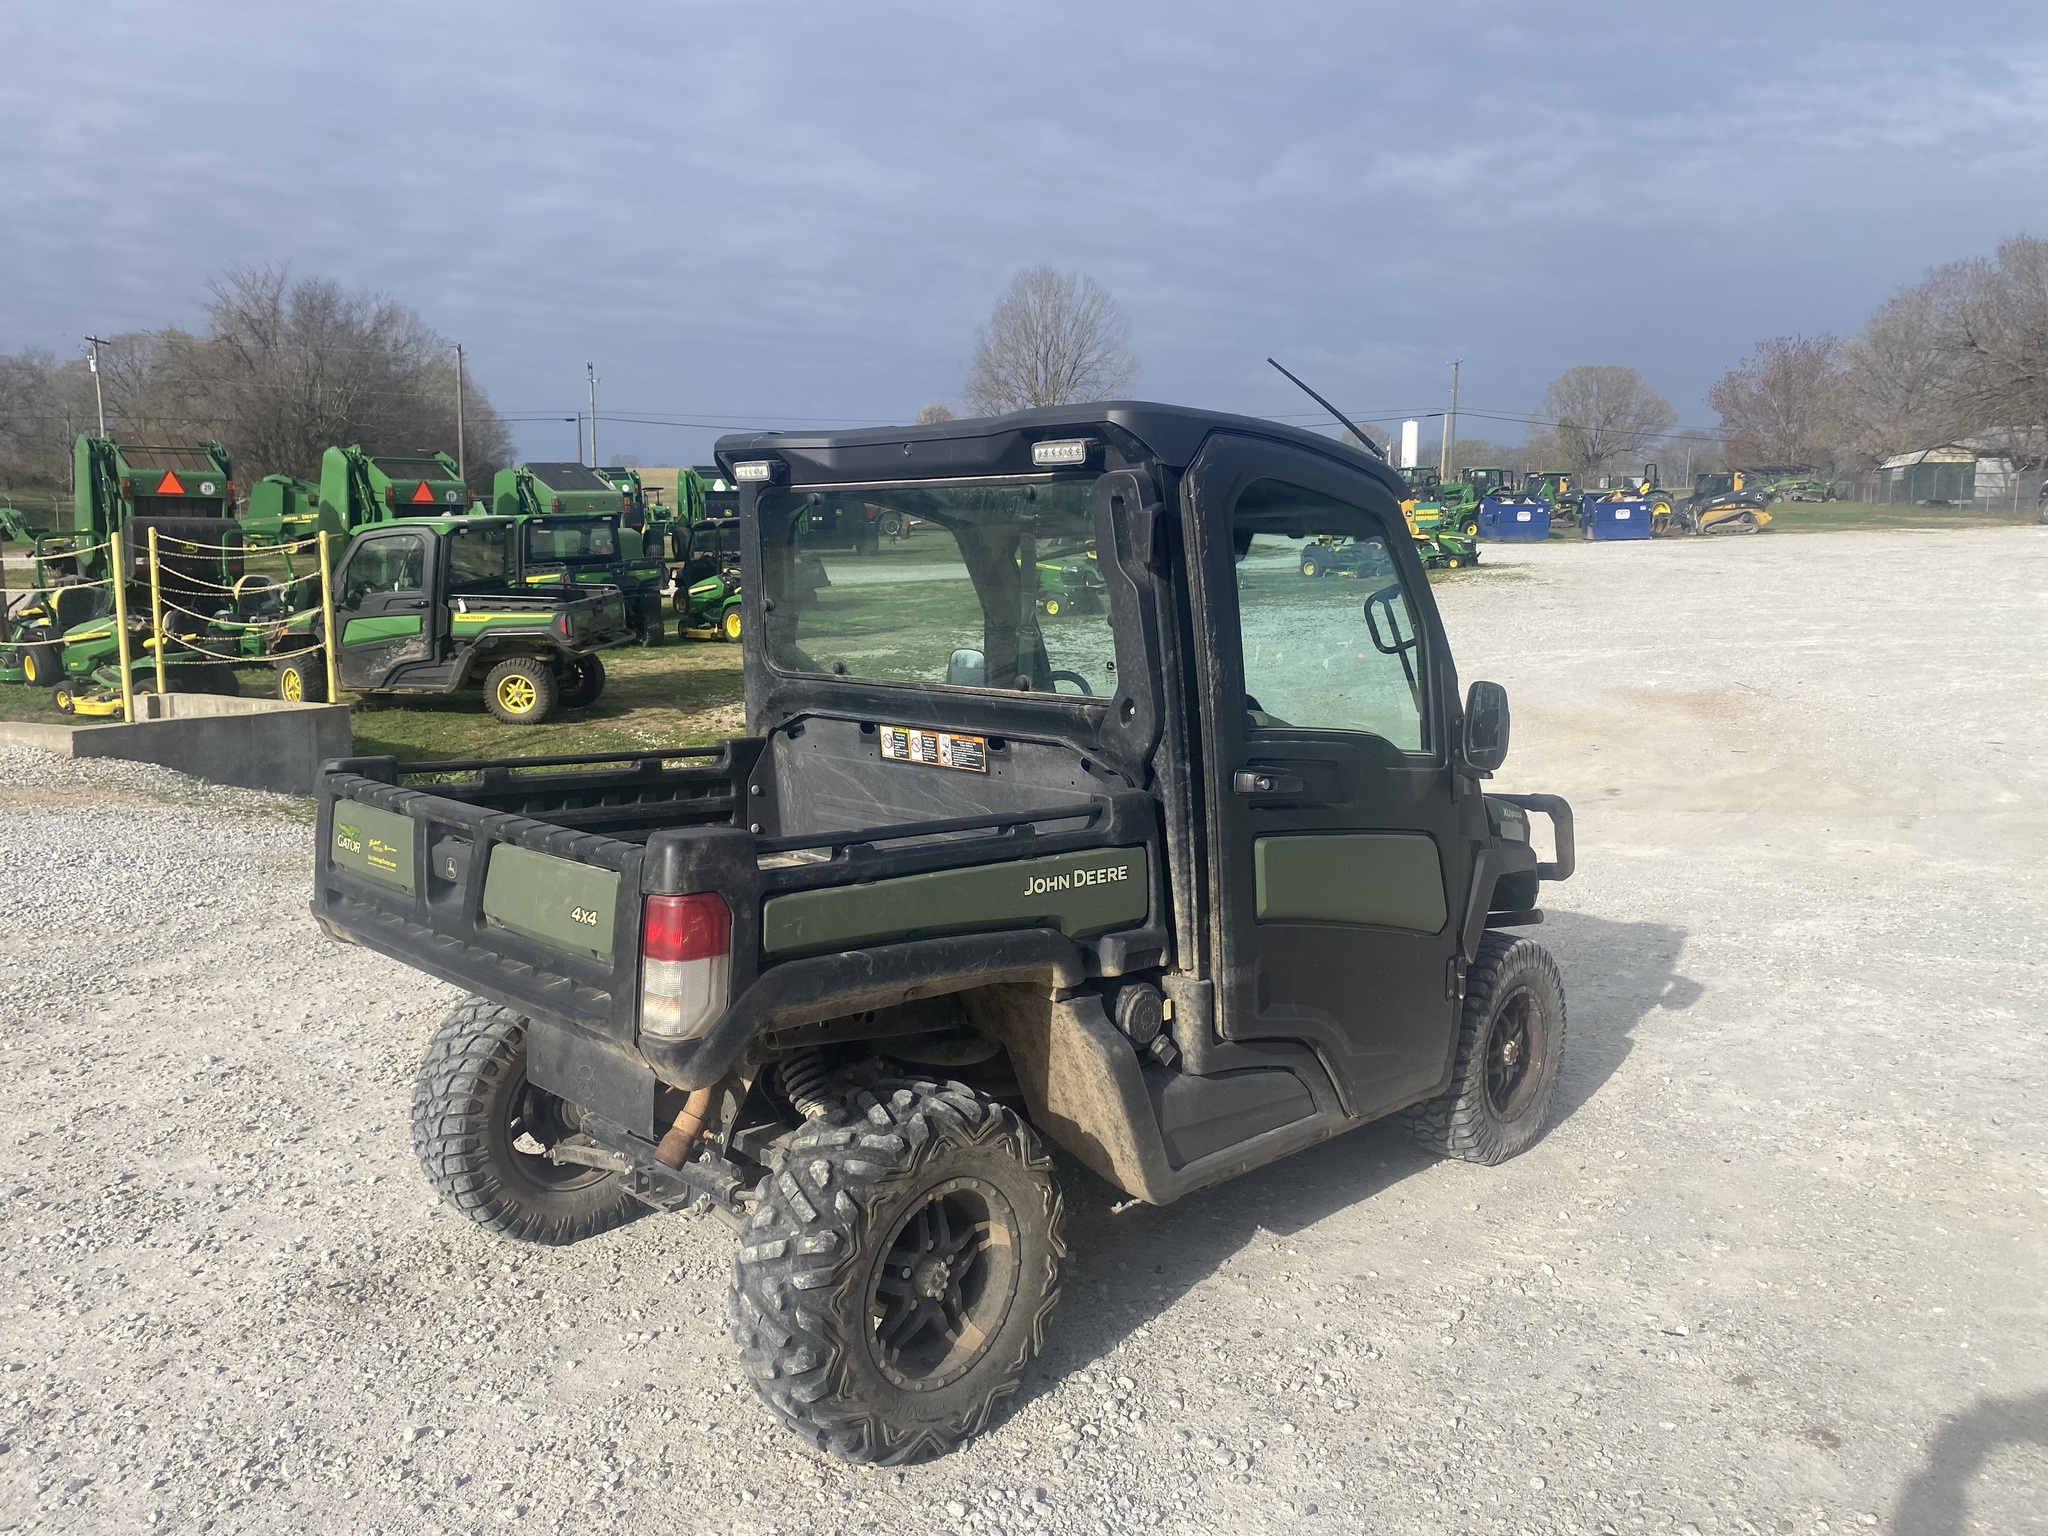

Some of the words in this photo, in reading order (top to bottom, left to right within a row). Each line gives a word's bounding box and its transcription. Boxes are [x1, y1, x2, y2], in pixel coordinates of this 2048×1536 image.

[337, 834, 361, 854] GATOR
[1023, 874, 1070, 896] JOHN
[1073, 865, 1128, 888] DEERE
